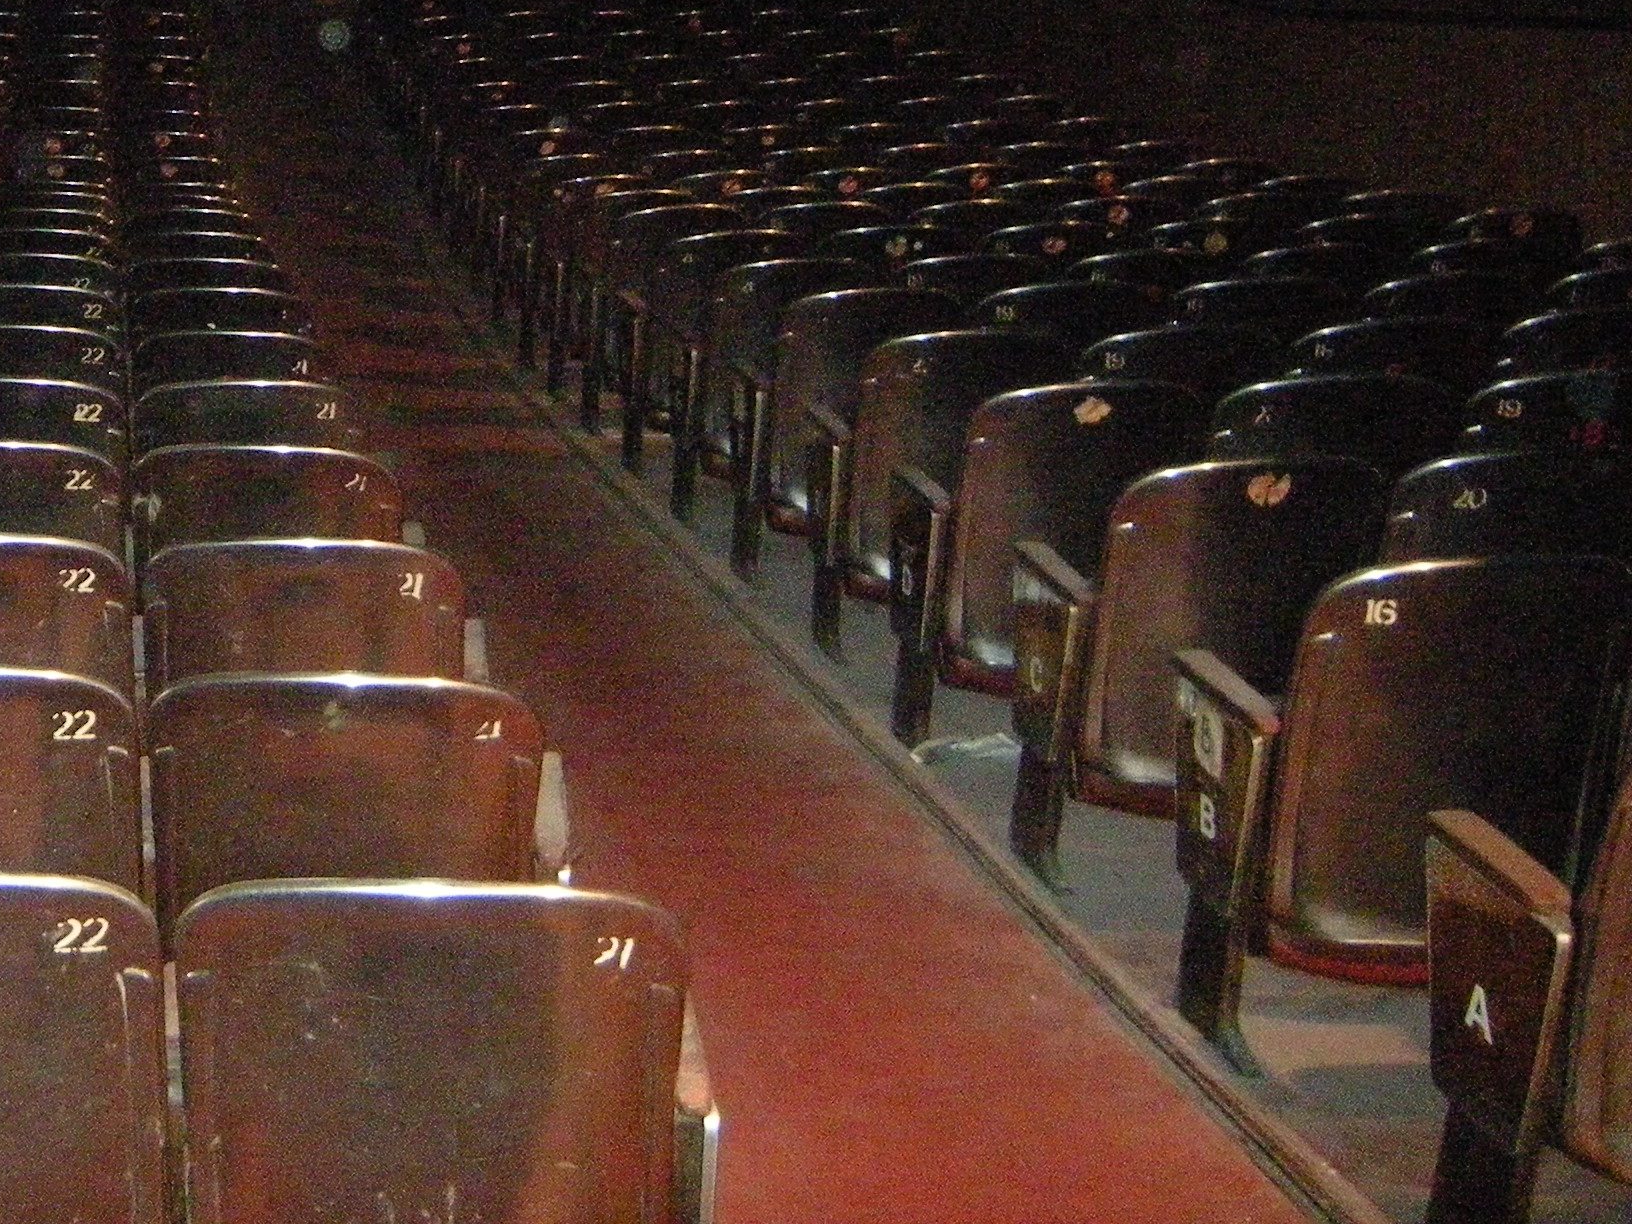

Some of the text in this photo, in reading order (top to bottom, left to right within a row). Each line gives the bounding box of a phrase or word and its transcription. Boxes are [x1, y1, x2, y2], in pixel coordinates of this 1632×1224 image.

[74, 403, 103, 423] 22
[316, 402, 337, 421] 21
[59, 567, 95, 594] 22
[399, 572, 424, 600] 21
[1366, 598, 1398, 626] 16
[1030, 657, 1044, 693] C
[52, 709, 97, 741] 22
[1199, 792, 1216, 839] B
[53, 916, 111, 954] 22
[594, 934, 636, 970] 21
[1464, 985, 1494, 1046] A
